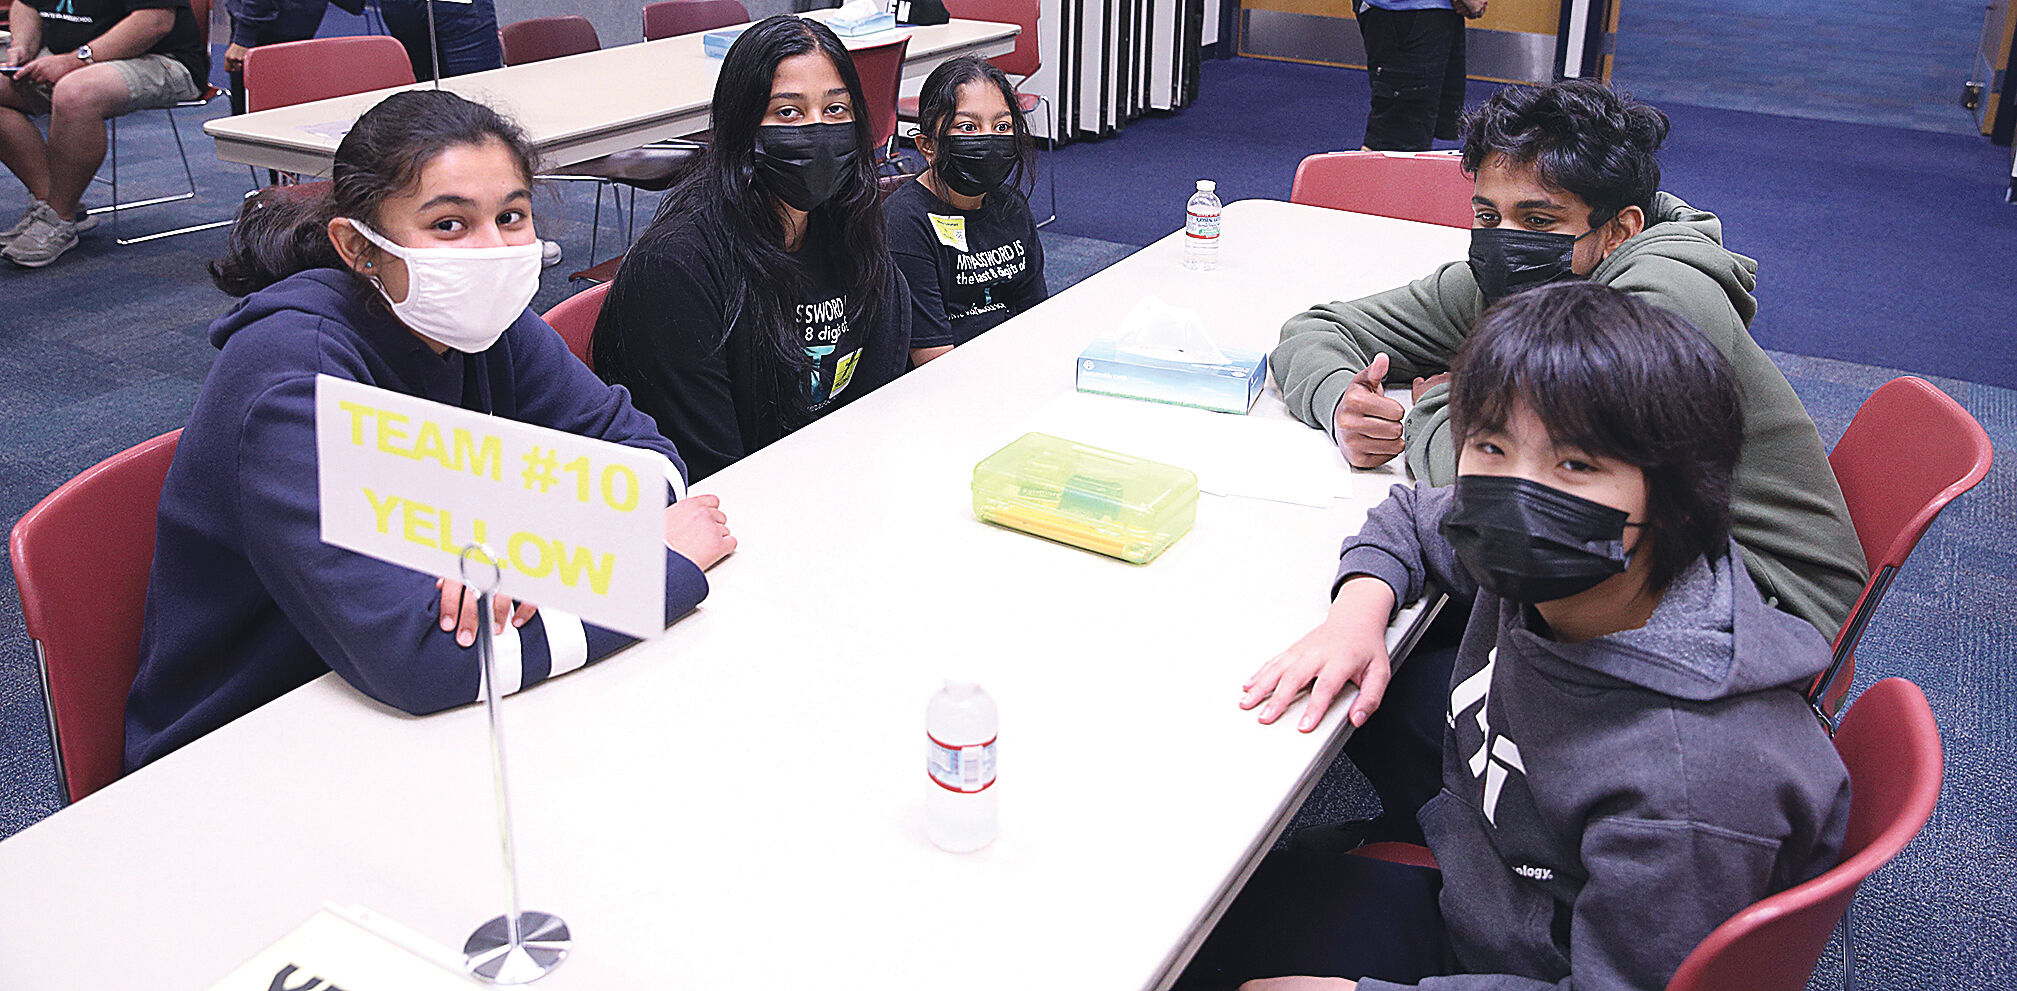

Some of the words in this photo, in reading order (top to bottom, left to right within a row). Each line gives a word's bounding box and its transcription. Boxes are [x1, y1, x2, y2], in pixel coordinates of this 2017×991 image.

[1012, 239, 1025, 257] IS
[956, 271, 975, 285] the
[973, 269, 993, 284] last
[805, 326, 814, 341] 8
[339, 399, 503, 482] TEAM
[521, 445, 640, 513] #10
[362, 486, 615, 596] YELLOW
